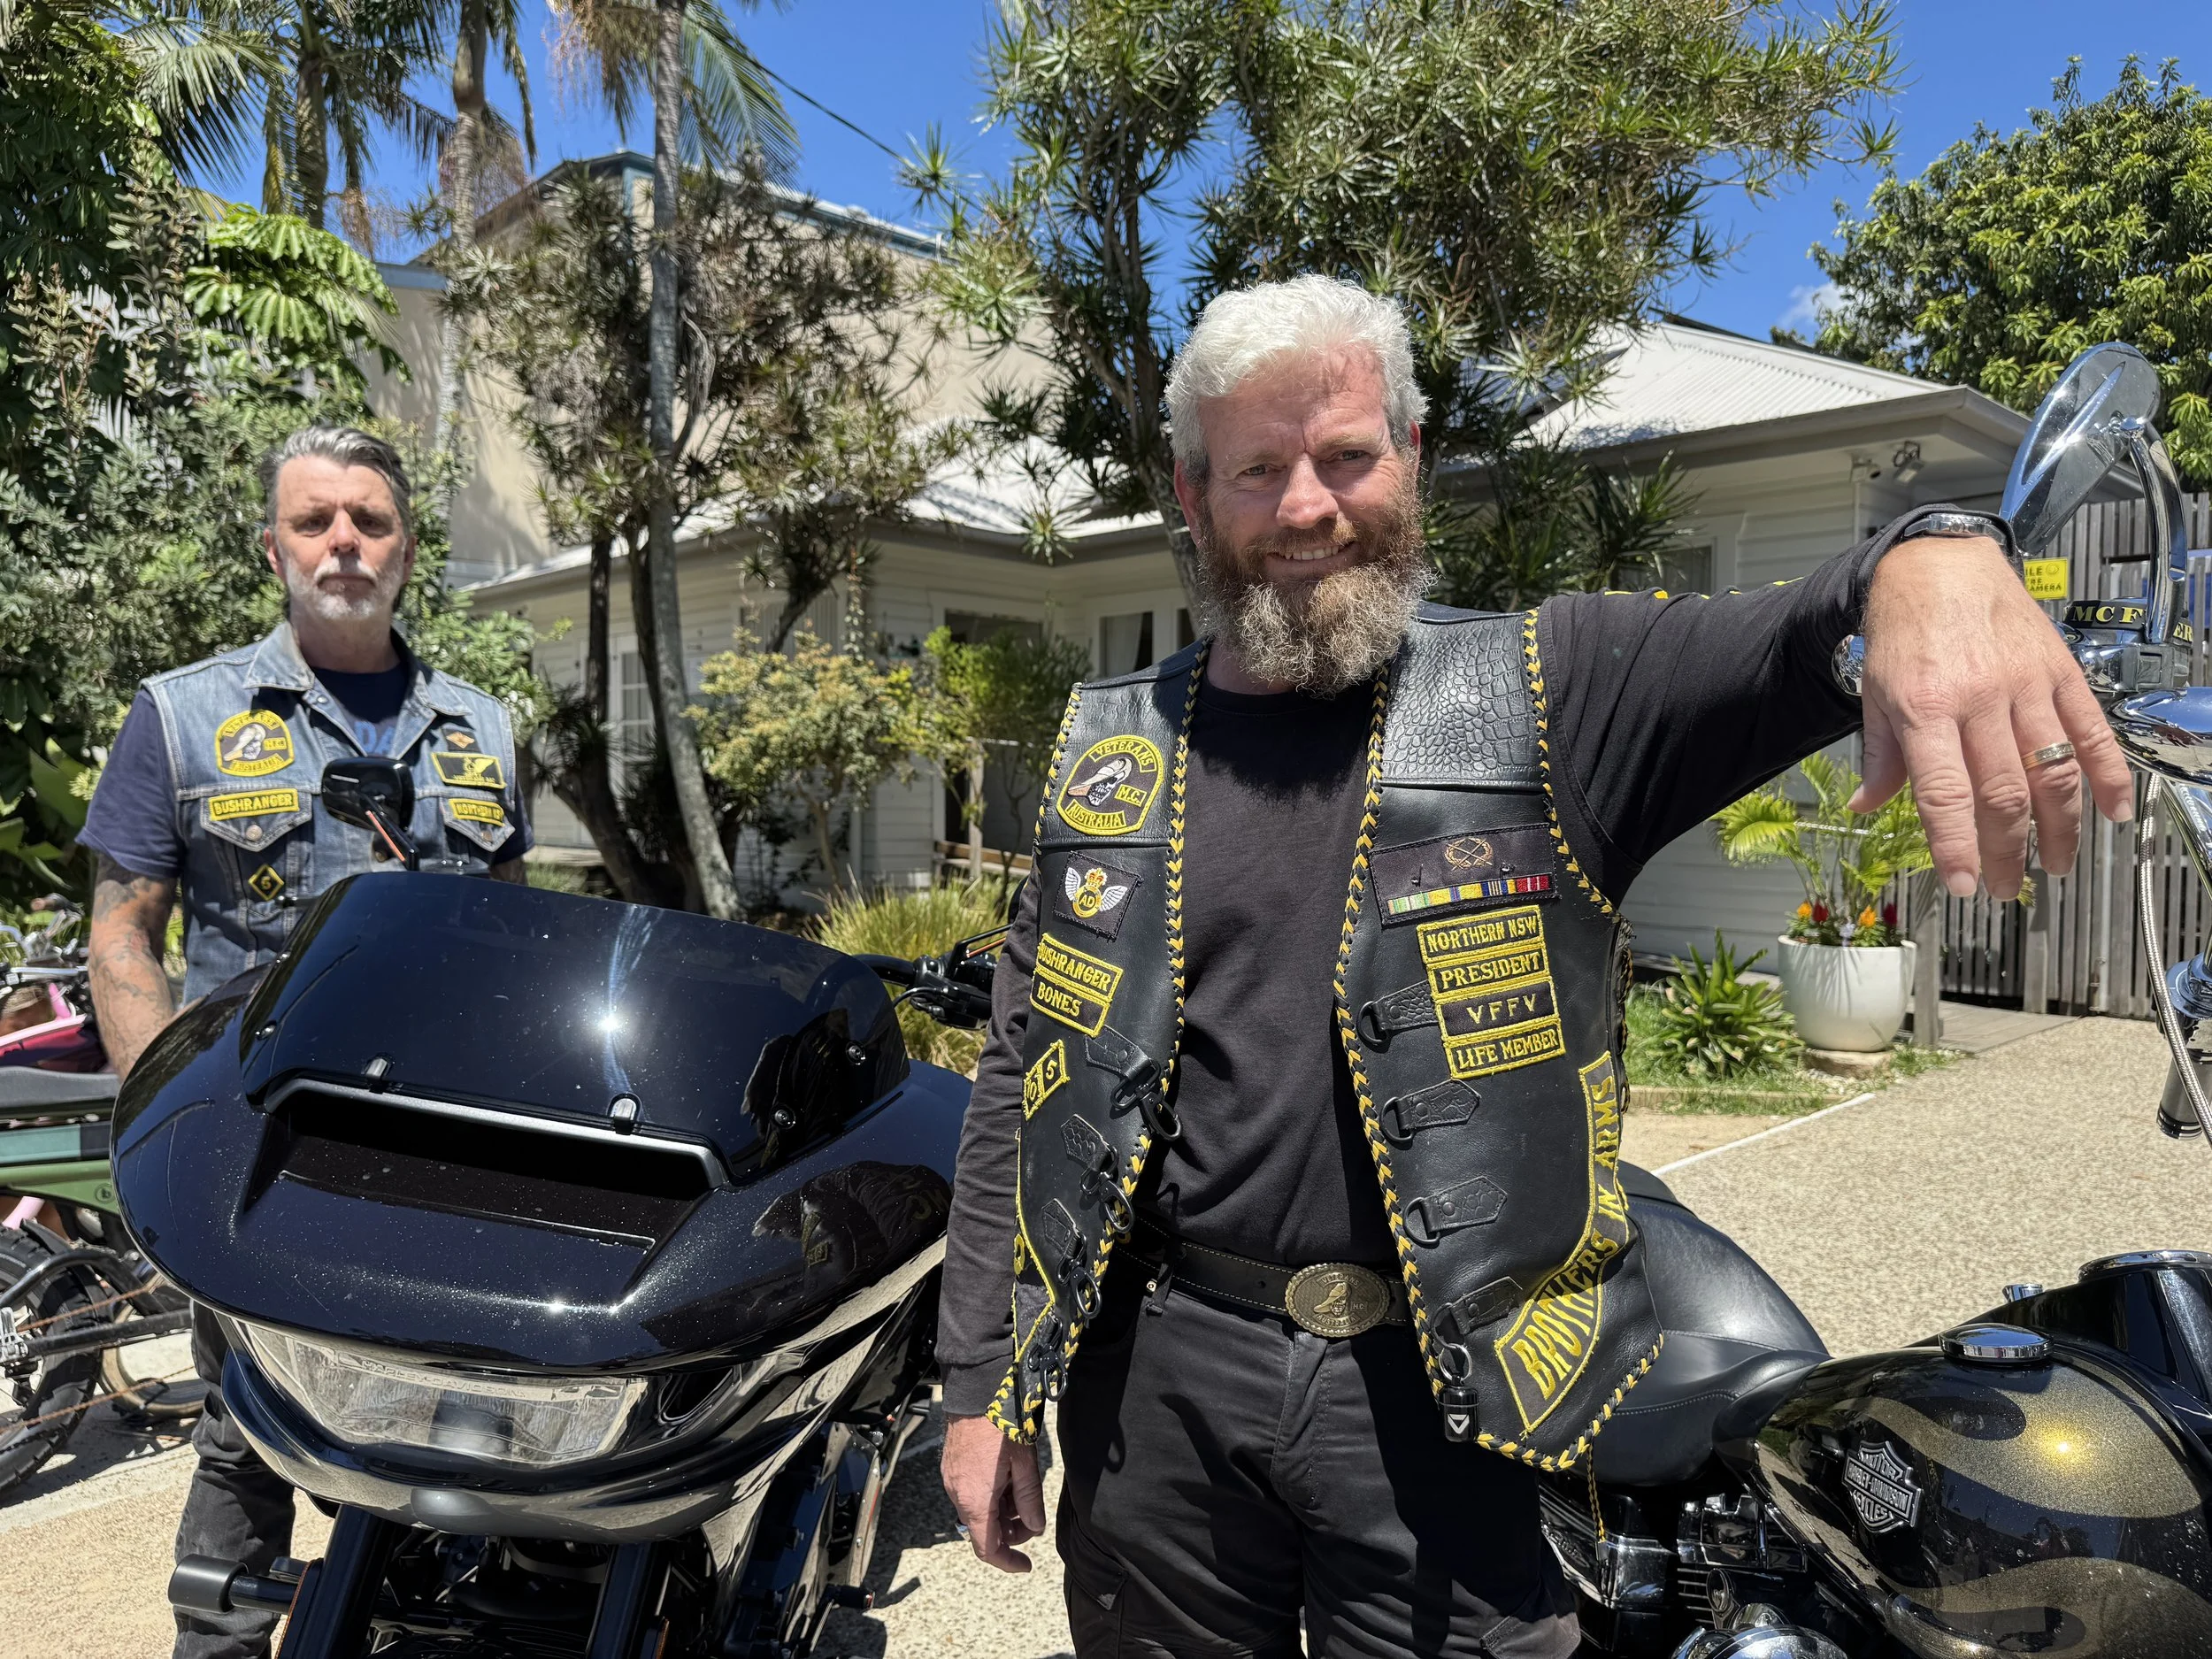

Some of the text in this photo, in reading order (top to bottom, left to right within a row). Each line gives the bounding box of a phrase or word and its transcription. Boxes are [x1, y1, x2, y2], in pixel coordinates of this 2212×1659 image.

[2027, 583, 2062, 592] AMERA
[1096, 741, 1154, 767] VETERANS
[212, 793, 293, 816] BUSHRANGER
[1117, 786, 1141, 804] M.C.
[1066, 804, 1122, 827] AUSTRALIA
[1079, 894, 1095, 908] AD
[1426, 915, 1538, 954] NORTHERN NSW
[1440, 951, 1541, 990] PRESIDENT
[1037, 981, 1083, 1018] BONES
[1455, 1029, 1558, 1070] LIFE MEMBER
[1045, 1059, 1058, 1080] 5
[1510, 1075, 1625, 1402] BROTHERS IN ARMS
[1321, 1273, 1360, 1286] VETERANS
[1316, 1315, 1356, 1327] AUSTRALIA
[1859, 1451, 1898, 1481] MOTOR
[1847, 1462, 1909, 1512] HARLEY-DAVIDSON
